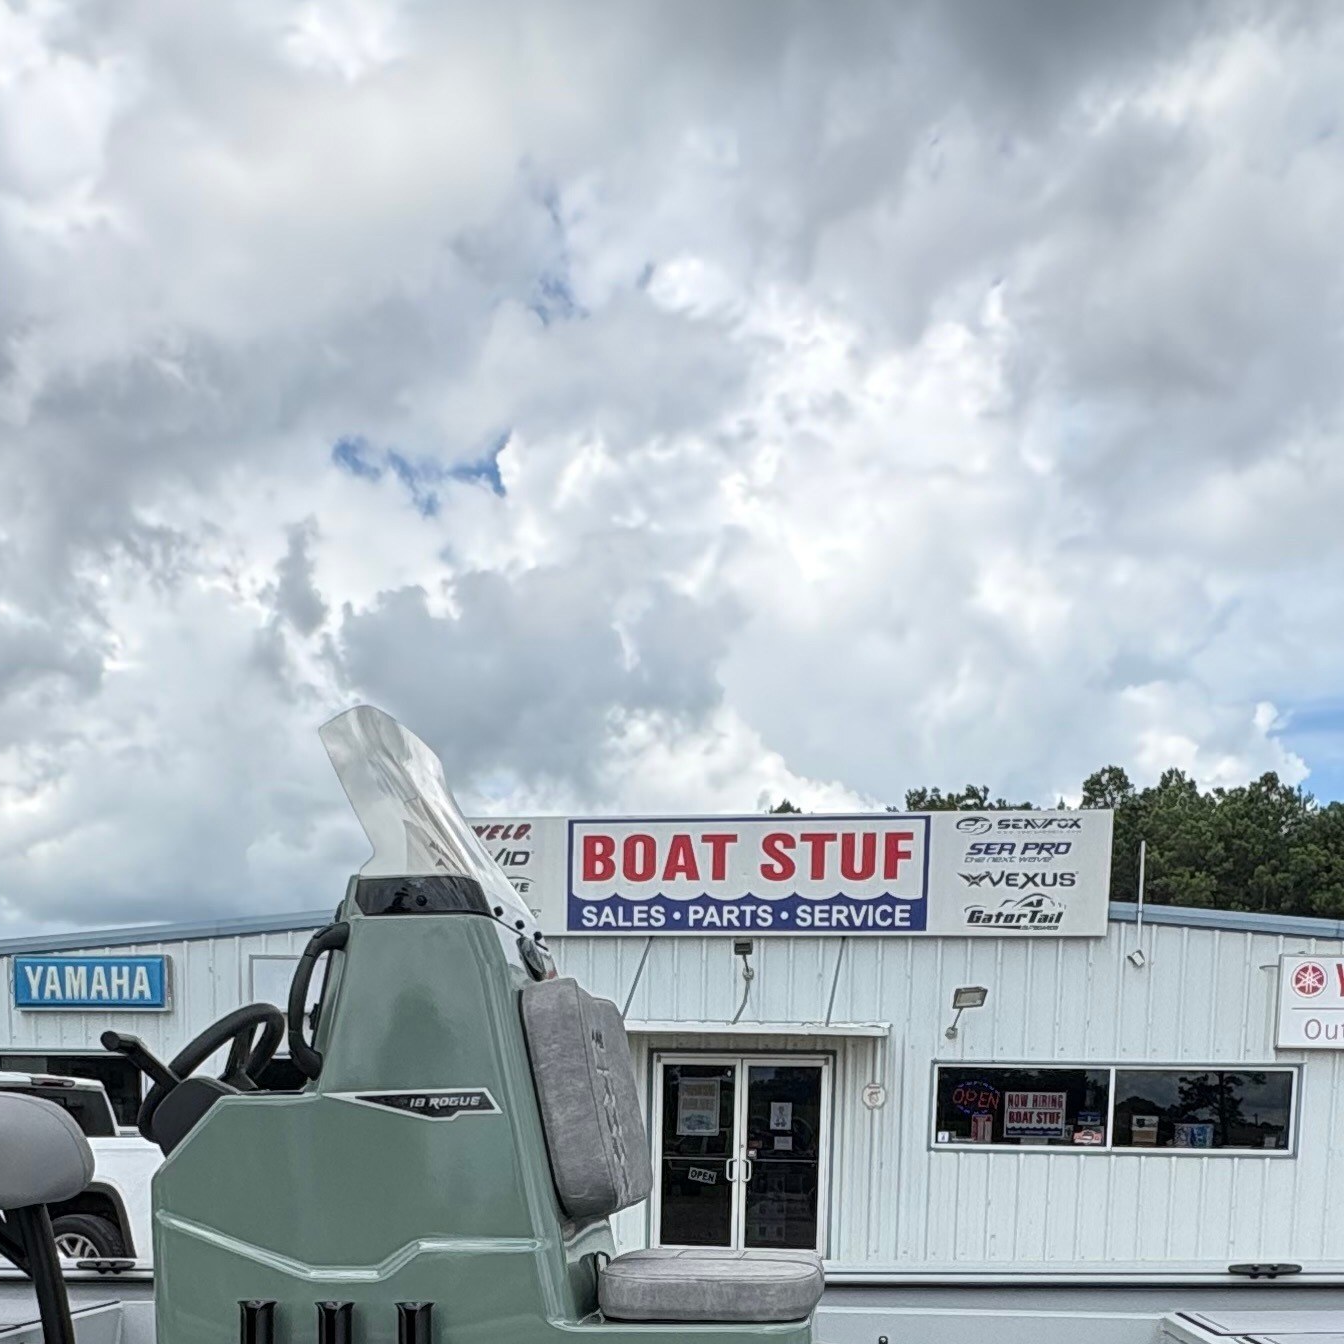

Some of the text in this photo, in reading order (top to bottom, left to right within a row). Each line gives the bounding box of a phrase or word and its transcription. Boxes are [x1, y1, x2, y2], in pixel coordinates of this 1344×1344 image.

[471, 823, 531, 840] WELD
[489, 847, 530, 866] VID
[582, 831, 914, 882] BOAT STUF
[965, 842, 1072, 858] SEA PRO
[986, 870, 1077, 890] VEXUS
[581, 904, 912, 927] SALES PARTS SERVICE
[24, 965, 152, 1001] YAMAHA
[428, 1096, 481, 1109] ROGUE
[953, 1088, 1000, 1110] OPEN
[1007, 1094, 1064, 1109] NOW HIRING
[1008, 1111, 1035, 1124] BOAT
[1036, 1111, 1062, 1125] STUF
[691, 1169, 715, 1182] OPEN
